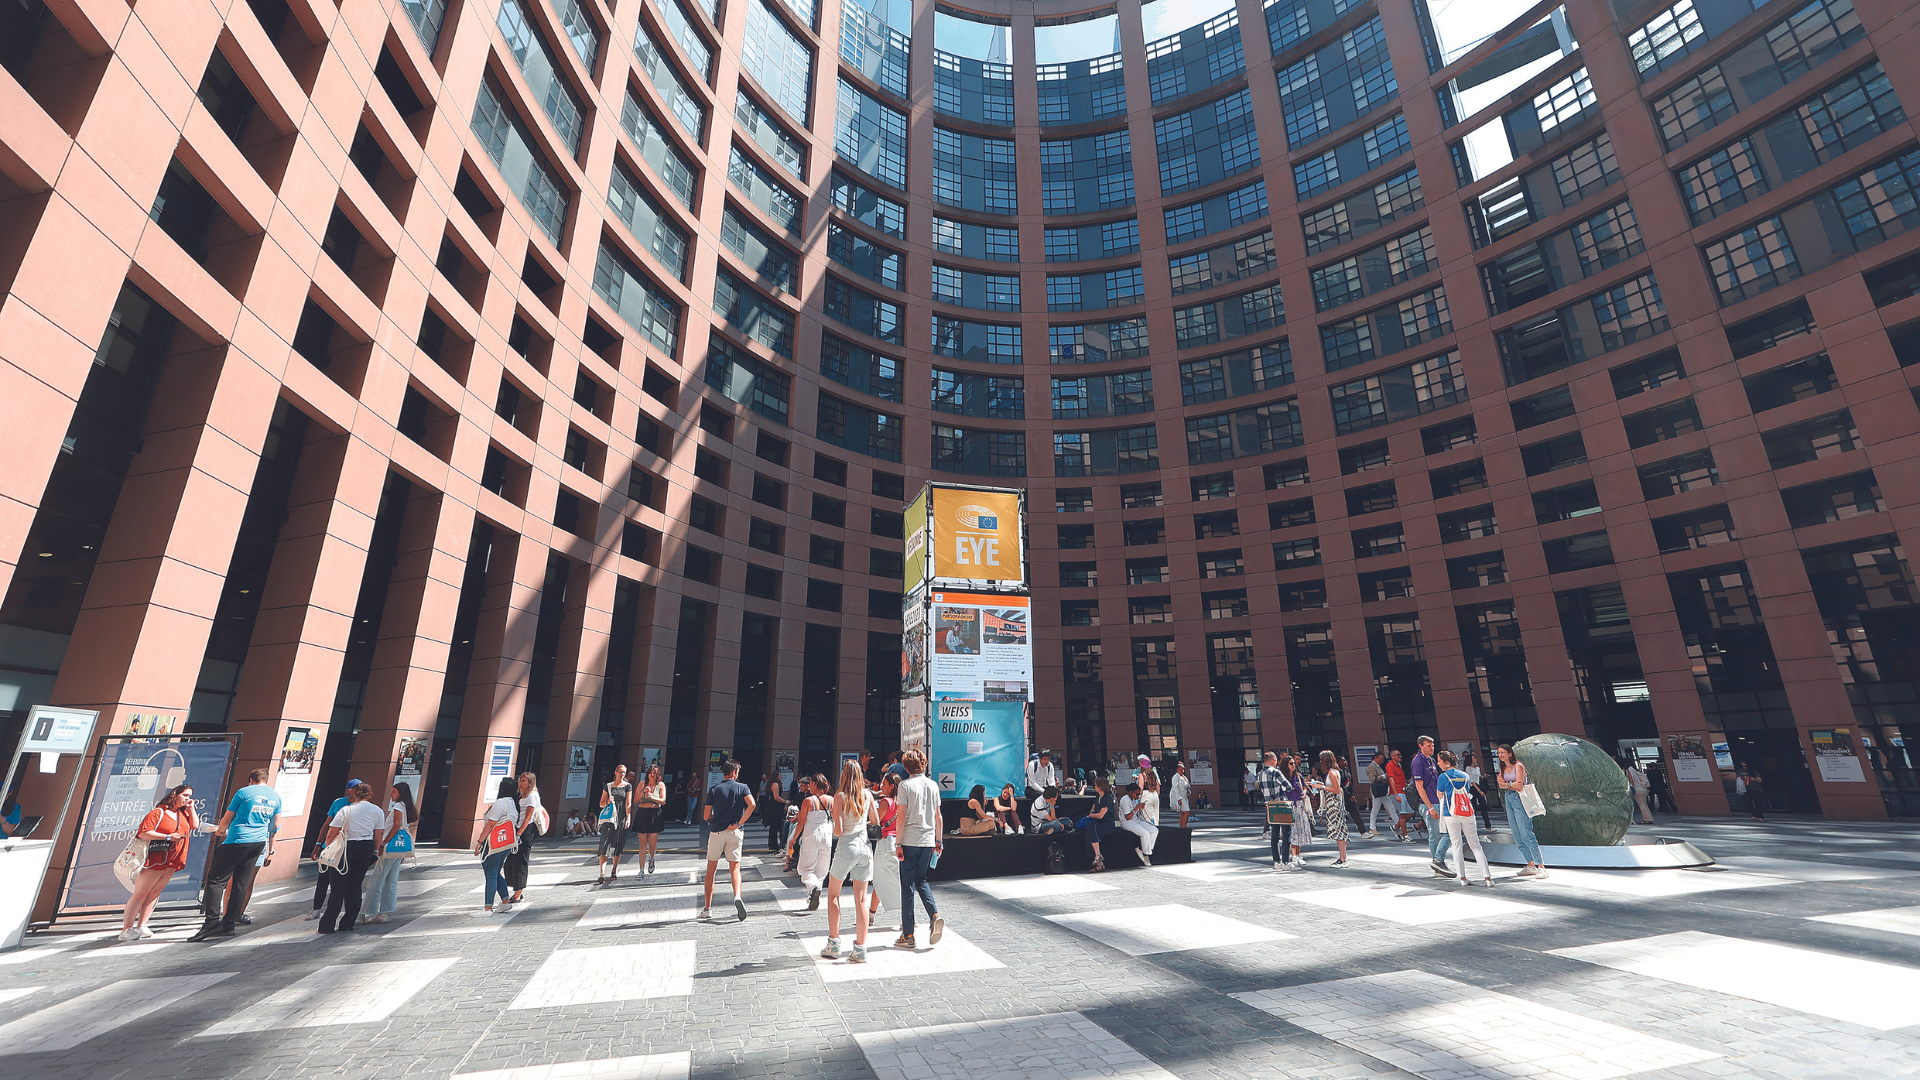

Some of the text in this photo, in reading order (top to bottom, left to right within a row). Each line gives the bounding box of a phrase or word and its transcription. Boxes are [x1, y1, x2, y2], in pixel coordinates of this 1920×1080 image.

[956, 536, 1000, 566] EYE
[942, 706, 970, 717] WEISS
[942, 722, 986, 734] BUILDING
[103, 799, 147, 812] ENTRÉE
